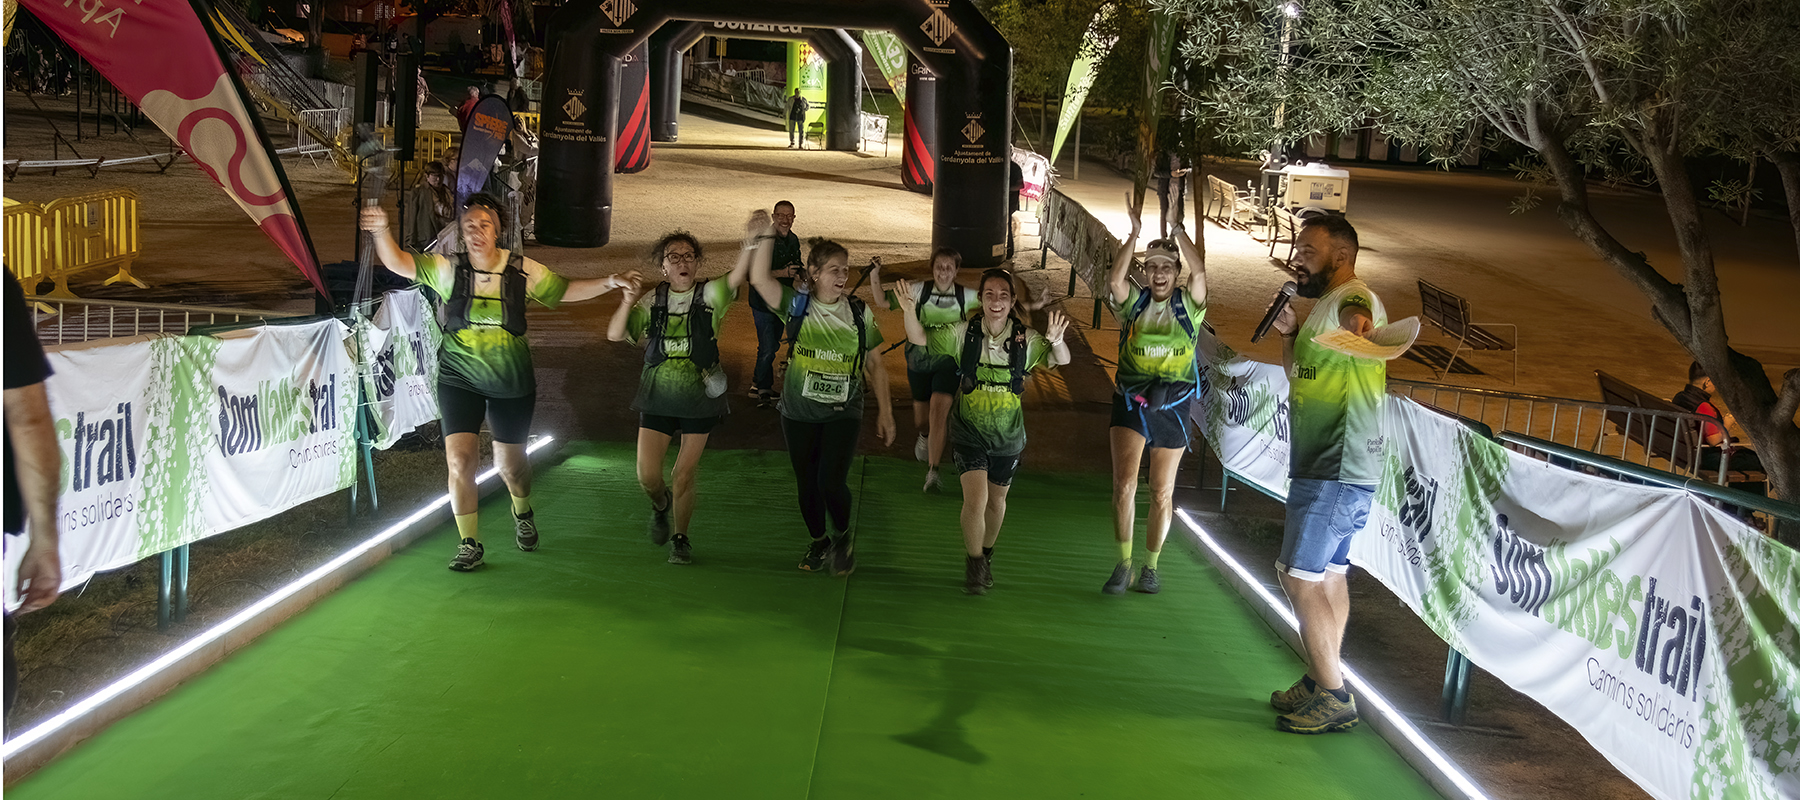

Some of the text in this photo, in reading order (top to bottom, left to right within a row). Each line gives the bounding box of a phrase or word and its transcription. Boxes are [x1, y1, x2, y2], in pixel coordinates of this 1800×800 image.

[543, 130, 575, 141] Cerdanyola
[813, 381, 842, 393] 032-C
[1586, 657, 1696, 749] Camins solidaris
